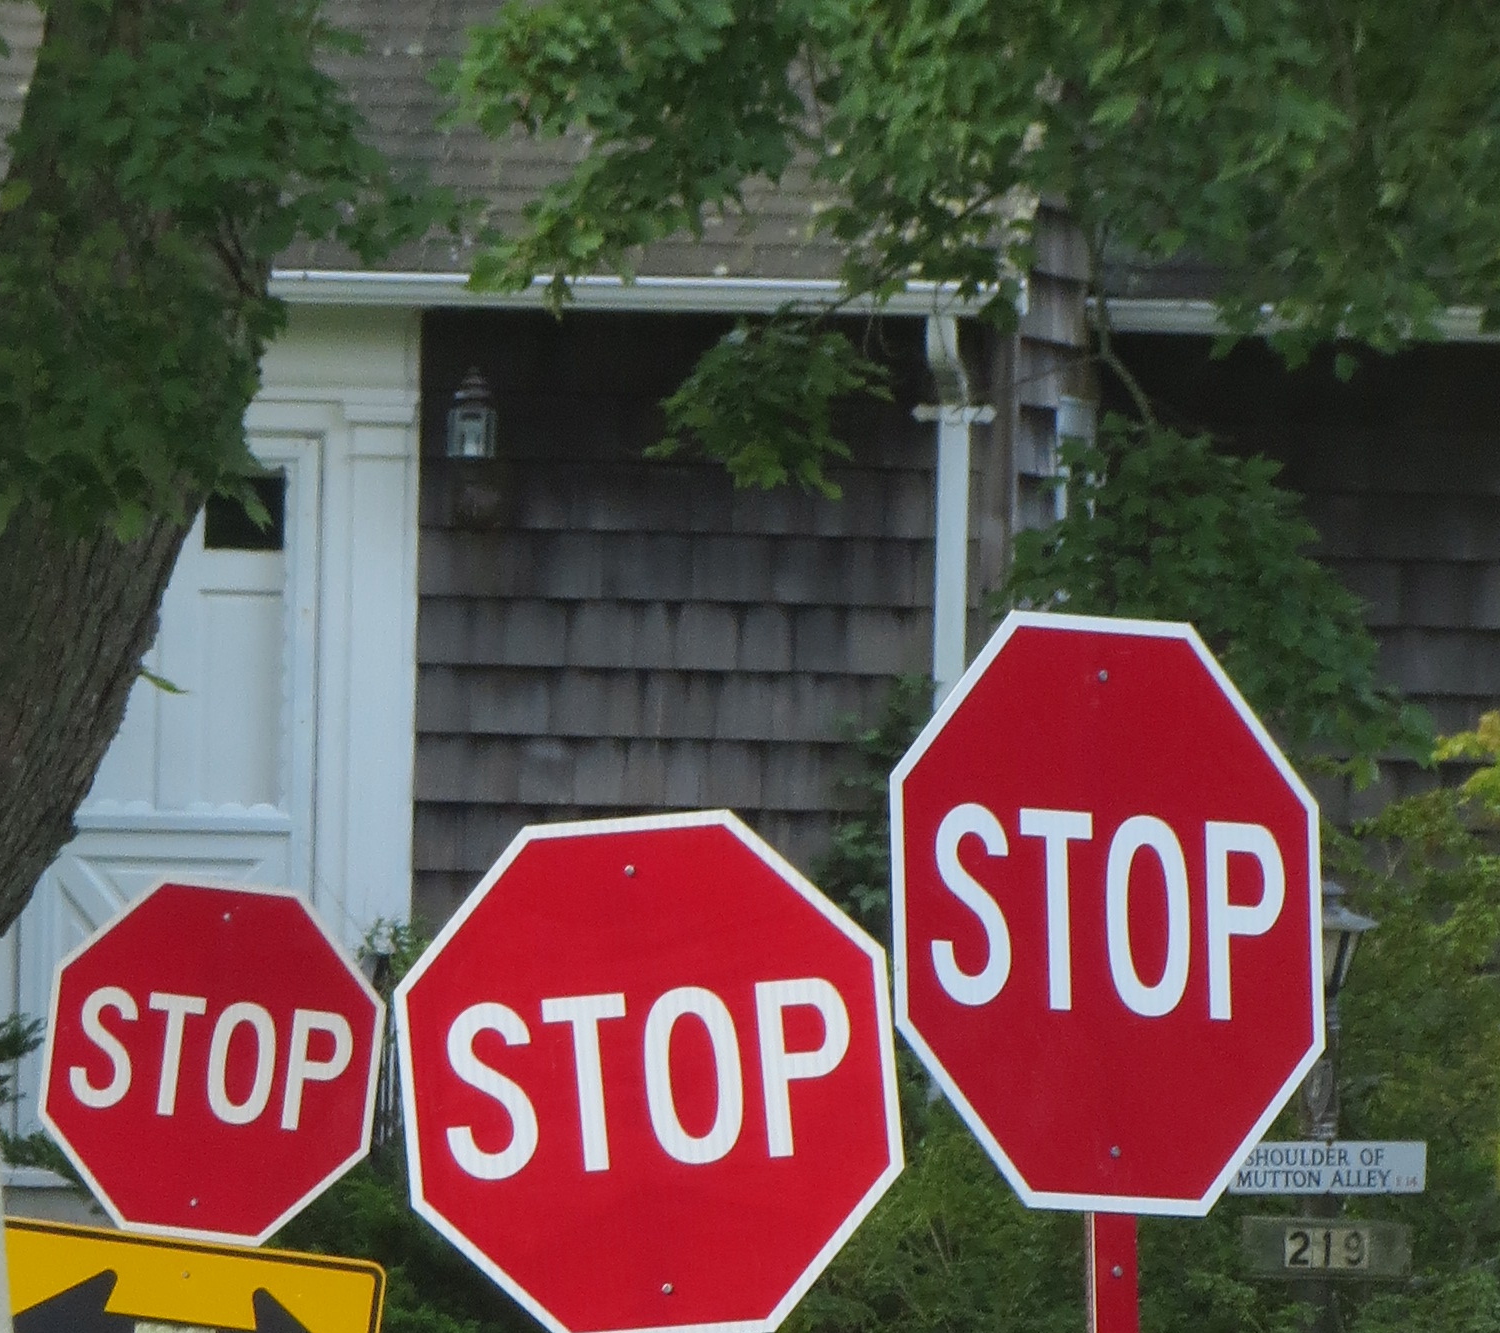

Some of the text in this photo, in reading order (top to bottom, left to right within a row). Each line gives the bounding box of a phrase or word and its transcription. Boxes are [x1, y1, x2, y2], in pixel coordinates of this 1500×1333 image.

[931, 803, 1285, 1020] STOP
[70, 987, 353, 1130] STOP
[447, 977, 850, 1180] STOP
[1236, 1170, 1321, 1188] MUTTON
[1331, 1169, 1391, 1188] ALLEY
[1245, 1148, 1385, 1166] SHOULDER OF
[1288, 1231, 1366, 1267] 219
